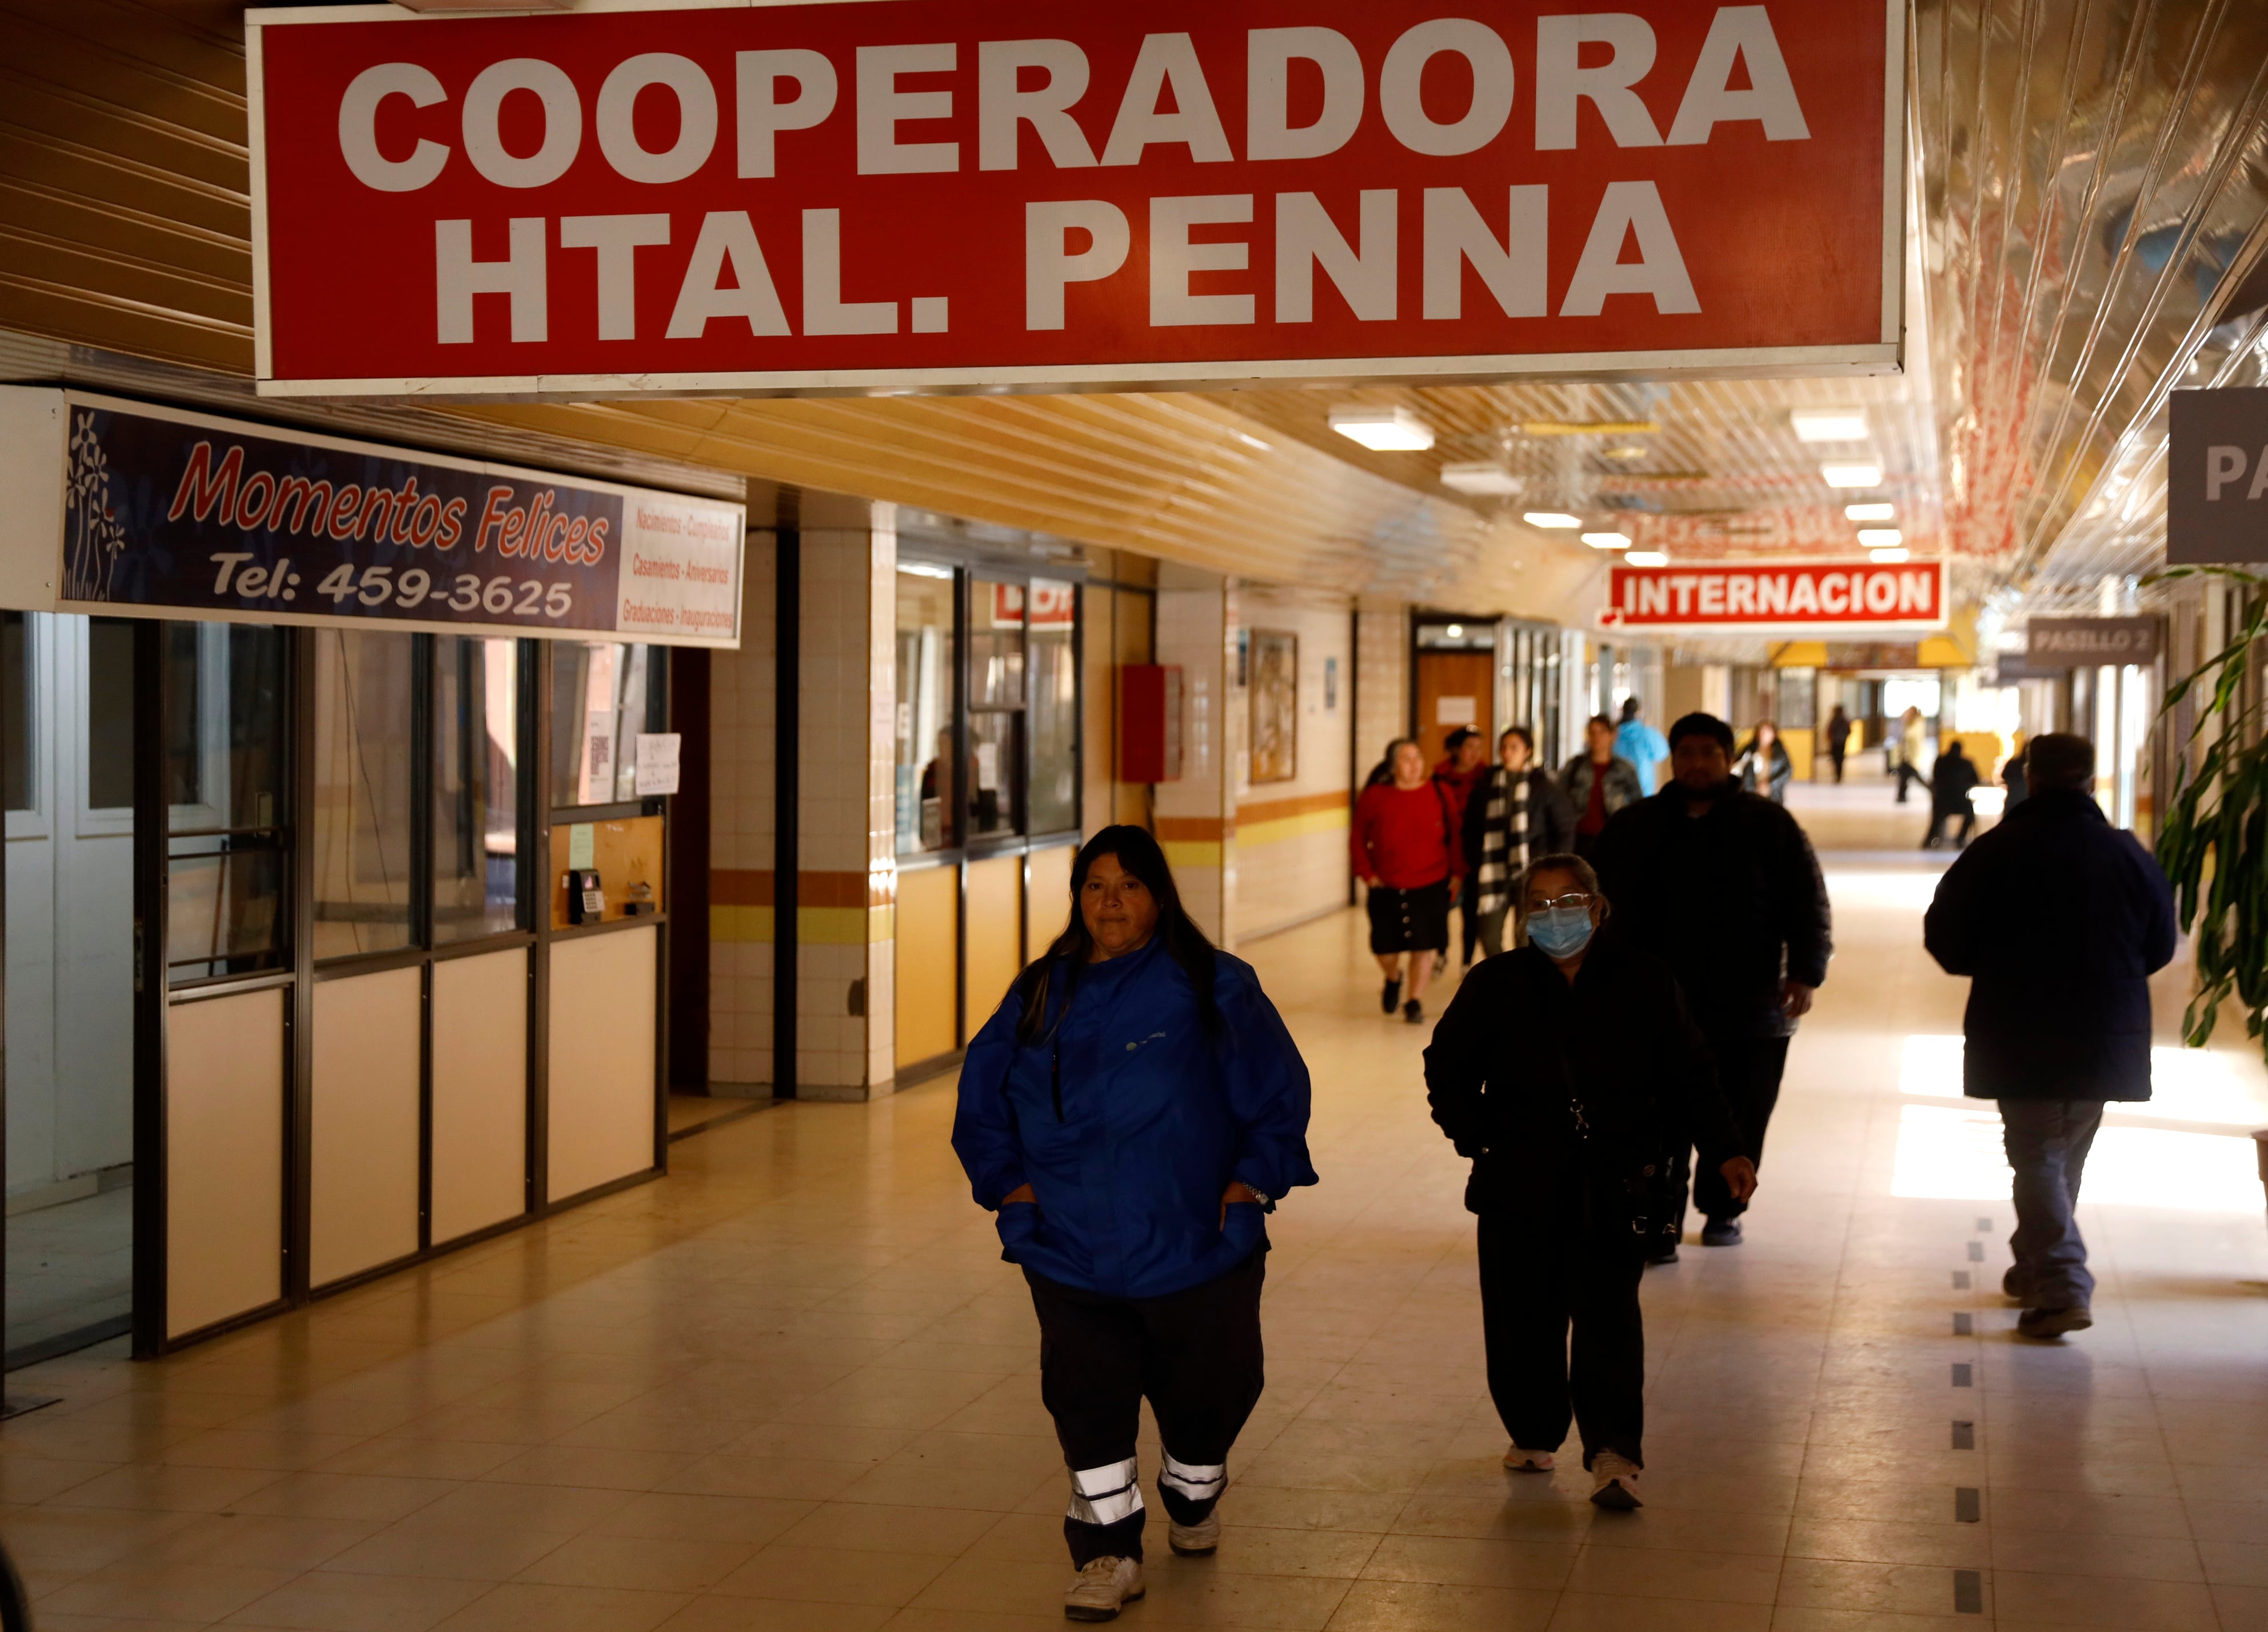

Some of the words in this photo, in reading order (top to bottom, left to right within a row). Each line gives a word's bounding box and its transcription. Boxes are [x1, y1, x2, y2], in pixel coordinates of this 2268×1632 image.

[338, 5, 1811, 192] COOPERADORA
[436, 208, 948, 344] HTAL.
[1026, 181, 1702, 331] PENNA
[168, 441, 467, 551] Momentos
[476, 485, 609, 566] Felices
[210, 552, 300, 601] Tel:
[317, 563, 572, 618] 459-3625
[633, 552, 680, 580] Casamientos
[686, 560, 729, 584] Aniversarios
[1623, 571, 1932, 615] INTERNACION
[623, 598, 674, 625] Graduaciones
[680, 603, 732, 631] Inauguraciones
[2034, 629, 2131, 653] PASILLO
[2135, 629, 2150, 651] 2
